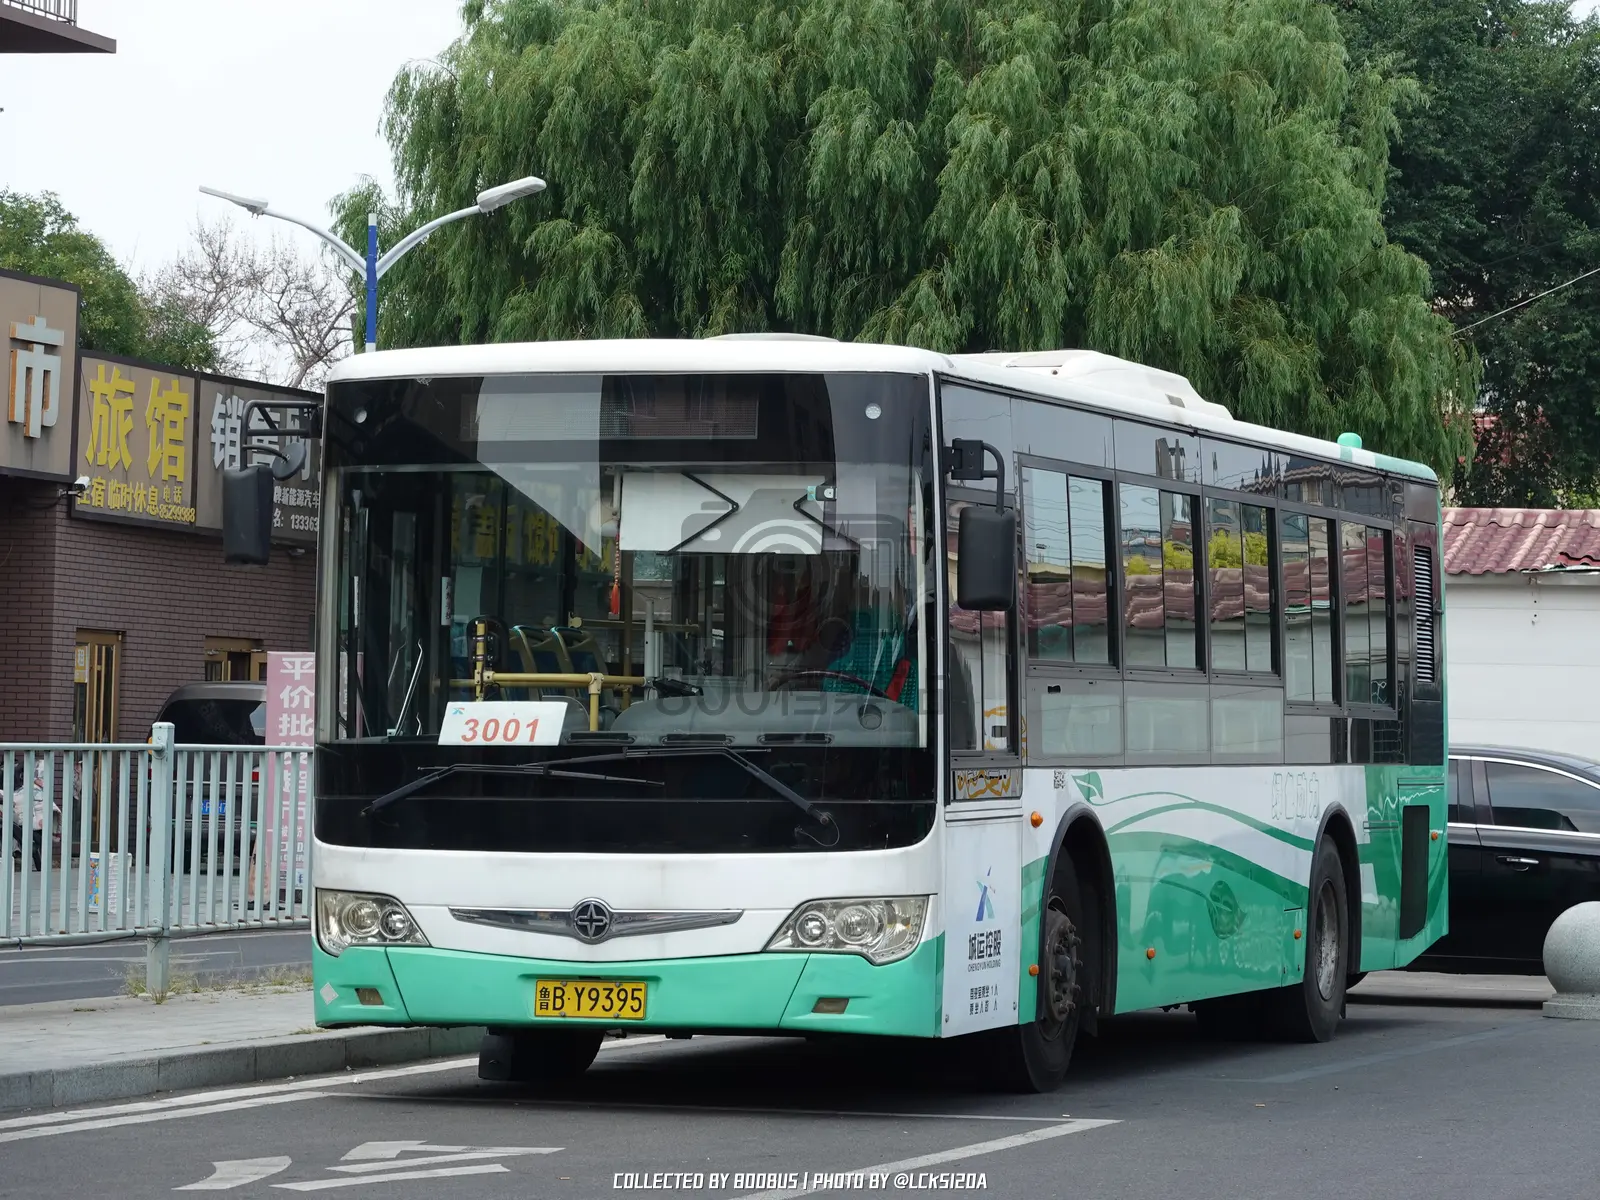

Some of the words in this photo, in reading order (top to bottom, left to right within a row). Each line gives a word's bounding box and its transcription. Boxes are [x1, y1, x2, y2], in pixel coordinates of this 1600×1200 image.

[8, 315, 65, 439] 市
[85, 364, 189, 482] 旅馆
[211, 392, 322, 481] 销售网
[163, 484, 182, 503] 电话
[460, 718, 539, 743] 3001
[968, 929, 1001, 960] 城运控股
